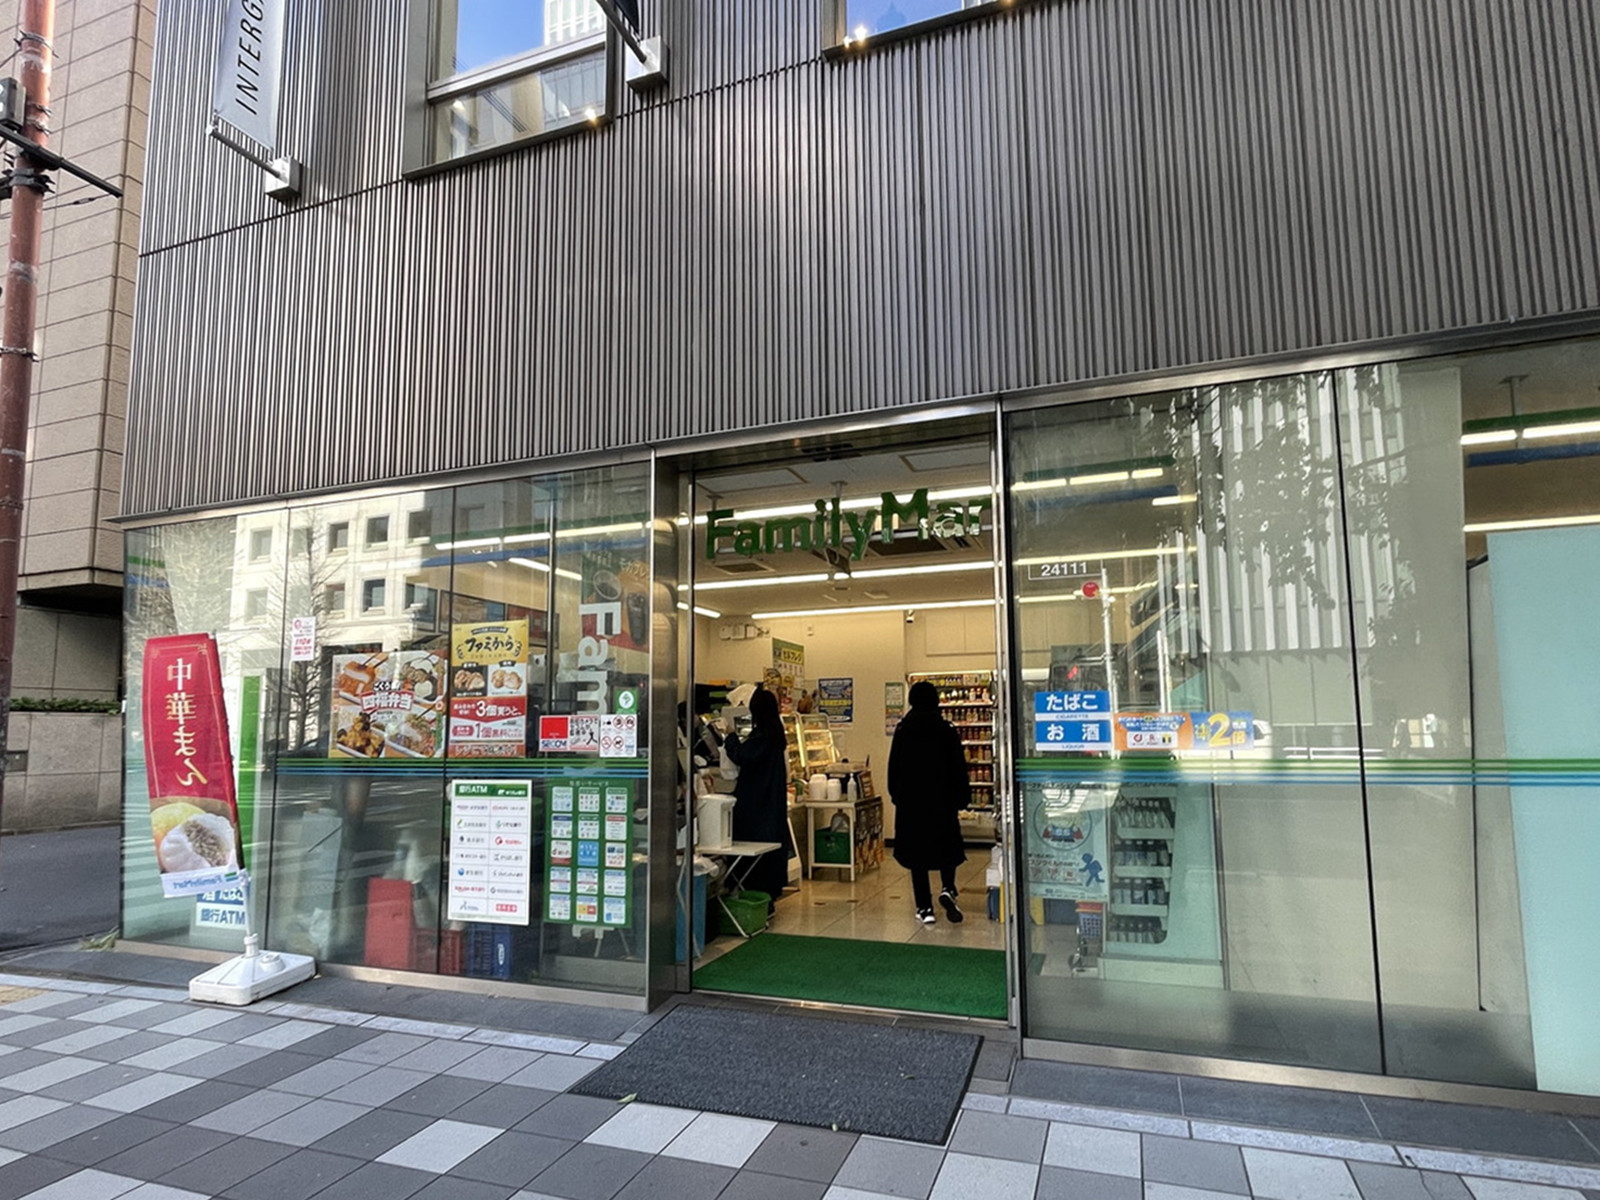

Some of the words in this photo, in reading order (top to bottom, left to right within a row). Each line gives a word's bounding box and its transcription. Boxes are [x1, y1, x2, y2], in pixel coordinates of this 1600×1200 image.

[235, 0, 264, 115] INTERG
[706, 488, 991, 560] FamilyMar
[1041, 562, 1087, 577] 24111
[1046, 693, 1098, 711] たばこ
[201, 907, 246, 925] 銀行ATM
